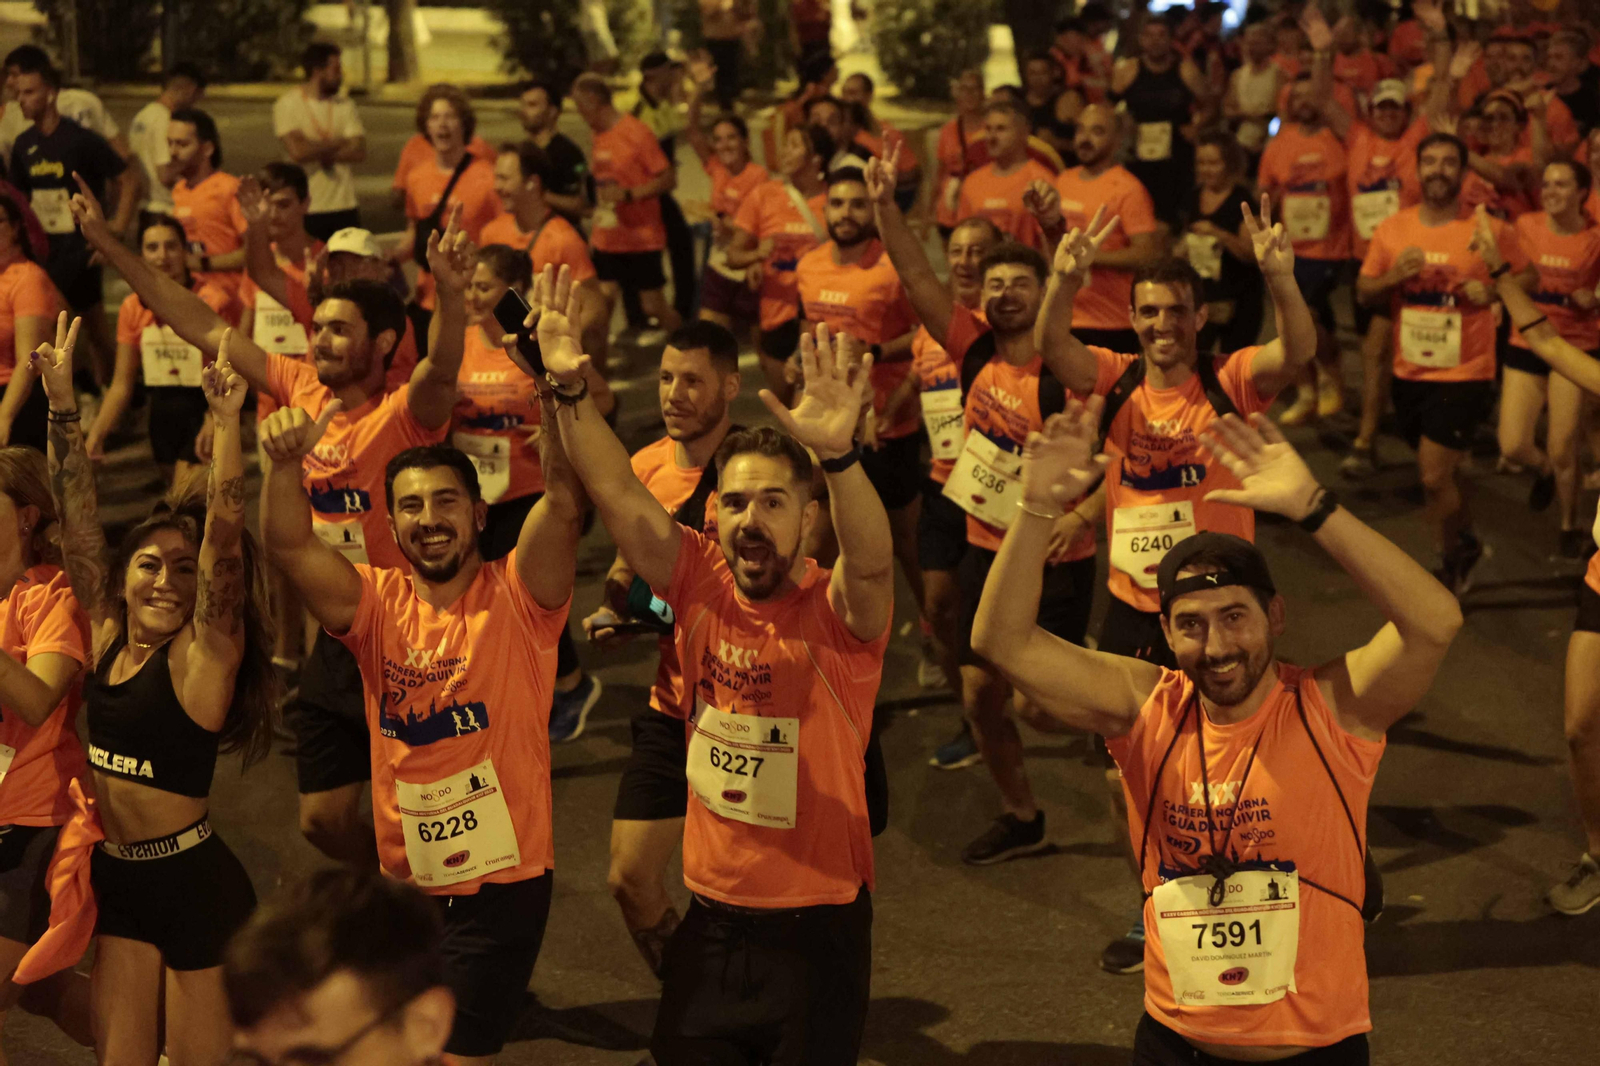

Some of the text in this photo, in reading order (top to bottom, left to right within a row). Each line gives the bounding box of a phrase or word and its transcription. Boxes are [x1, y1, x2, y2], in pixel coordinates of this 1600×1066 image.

[971, 464, 1007, 494] 6236
[1131, 534, 1173, 553] 6240
[710, 746, 765, 778] 6227
[1188, 780, 1242, 806] XXX
[418, 810, 478, 843] 6228
[1168, 809, 1272, 833] GUADALUIVIR
[1192, 919, 1262, 949] 7591
[1191, 954, 1210, 962] DAVID
